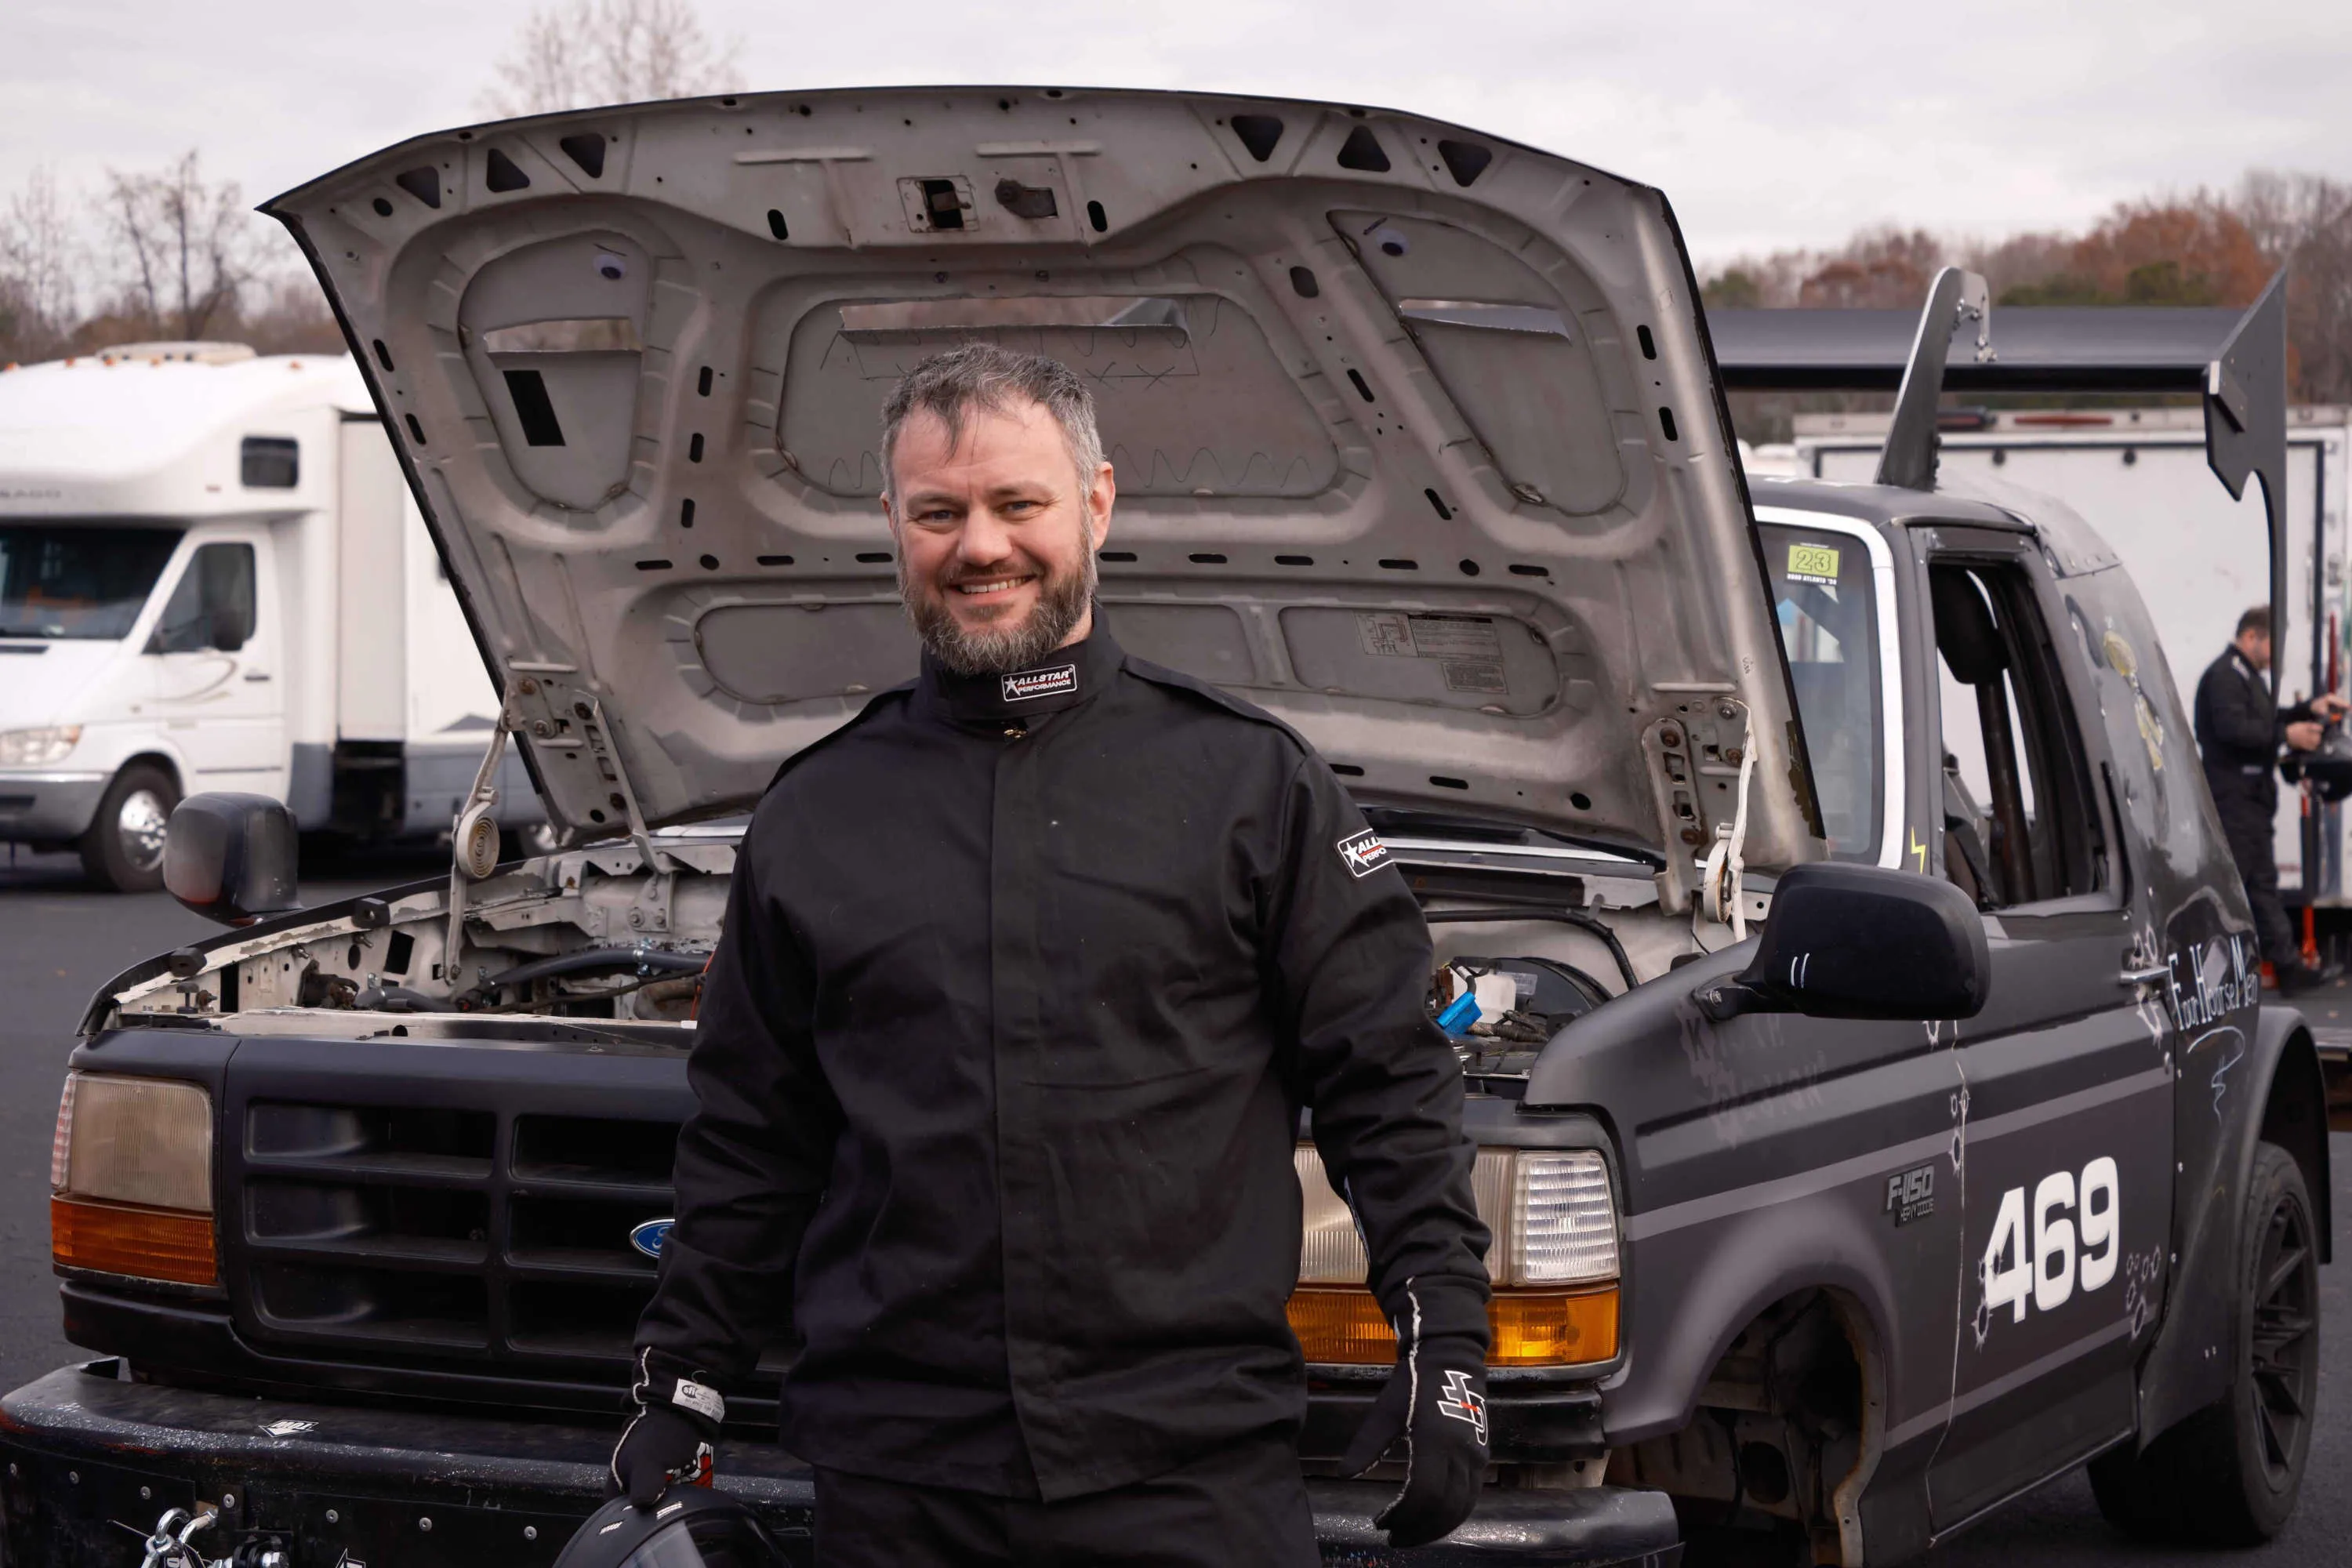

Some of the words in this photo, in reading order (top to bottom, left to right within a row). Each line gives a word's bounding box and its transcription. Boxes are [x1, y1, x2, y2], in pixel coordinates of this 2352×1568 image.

[1795, 550, 1831, 572] 23
[1017, 670, 1069, 686] ALLSTAR
[1018, 679, 1072, 692] PERFORMANCE
[1984, 1156, 2120, 1324] 469
